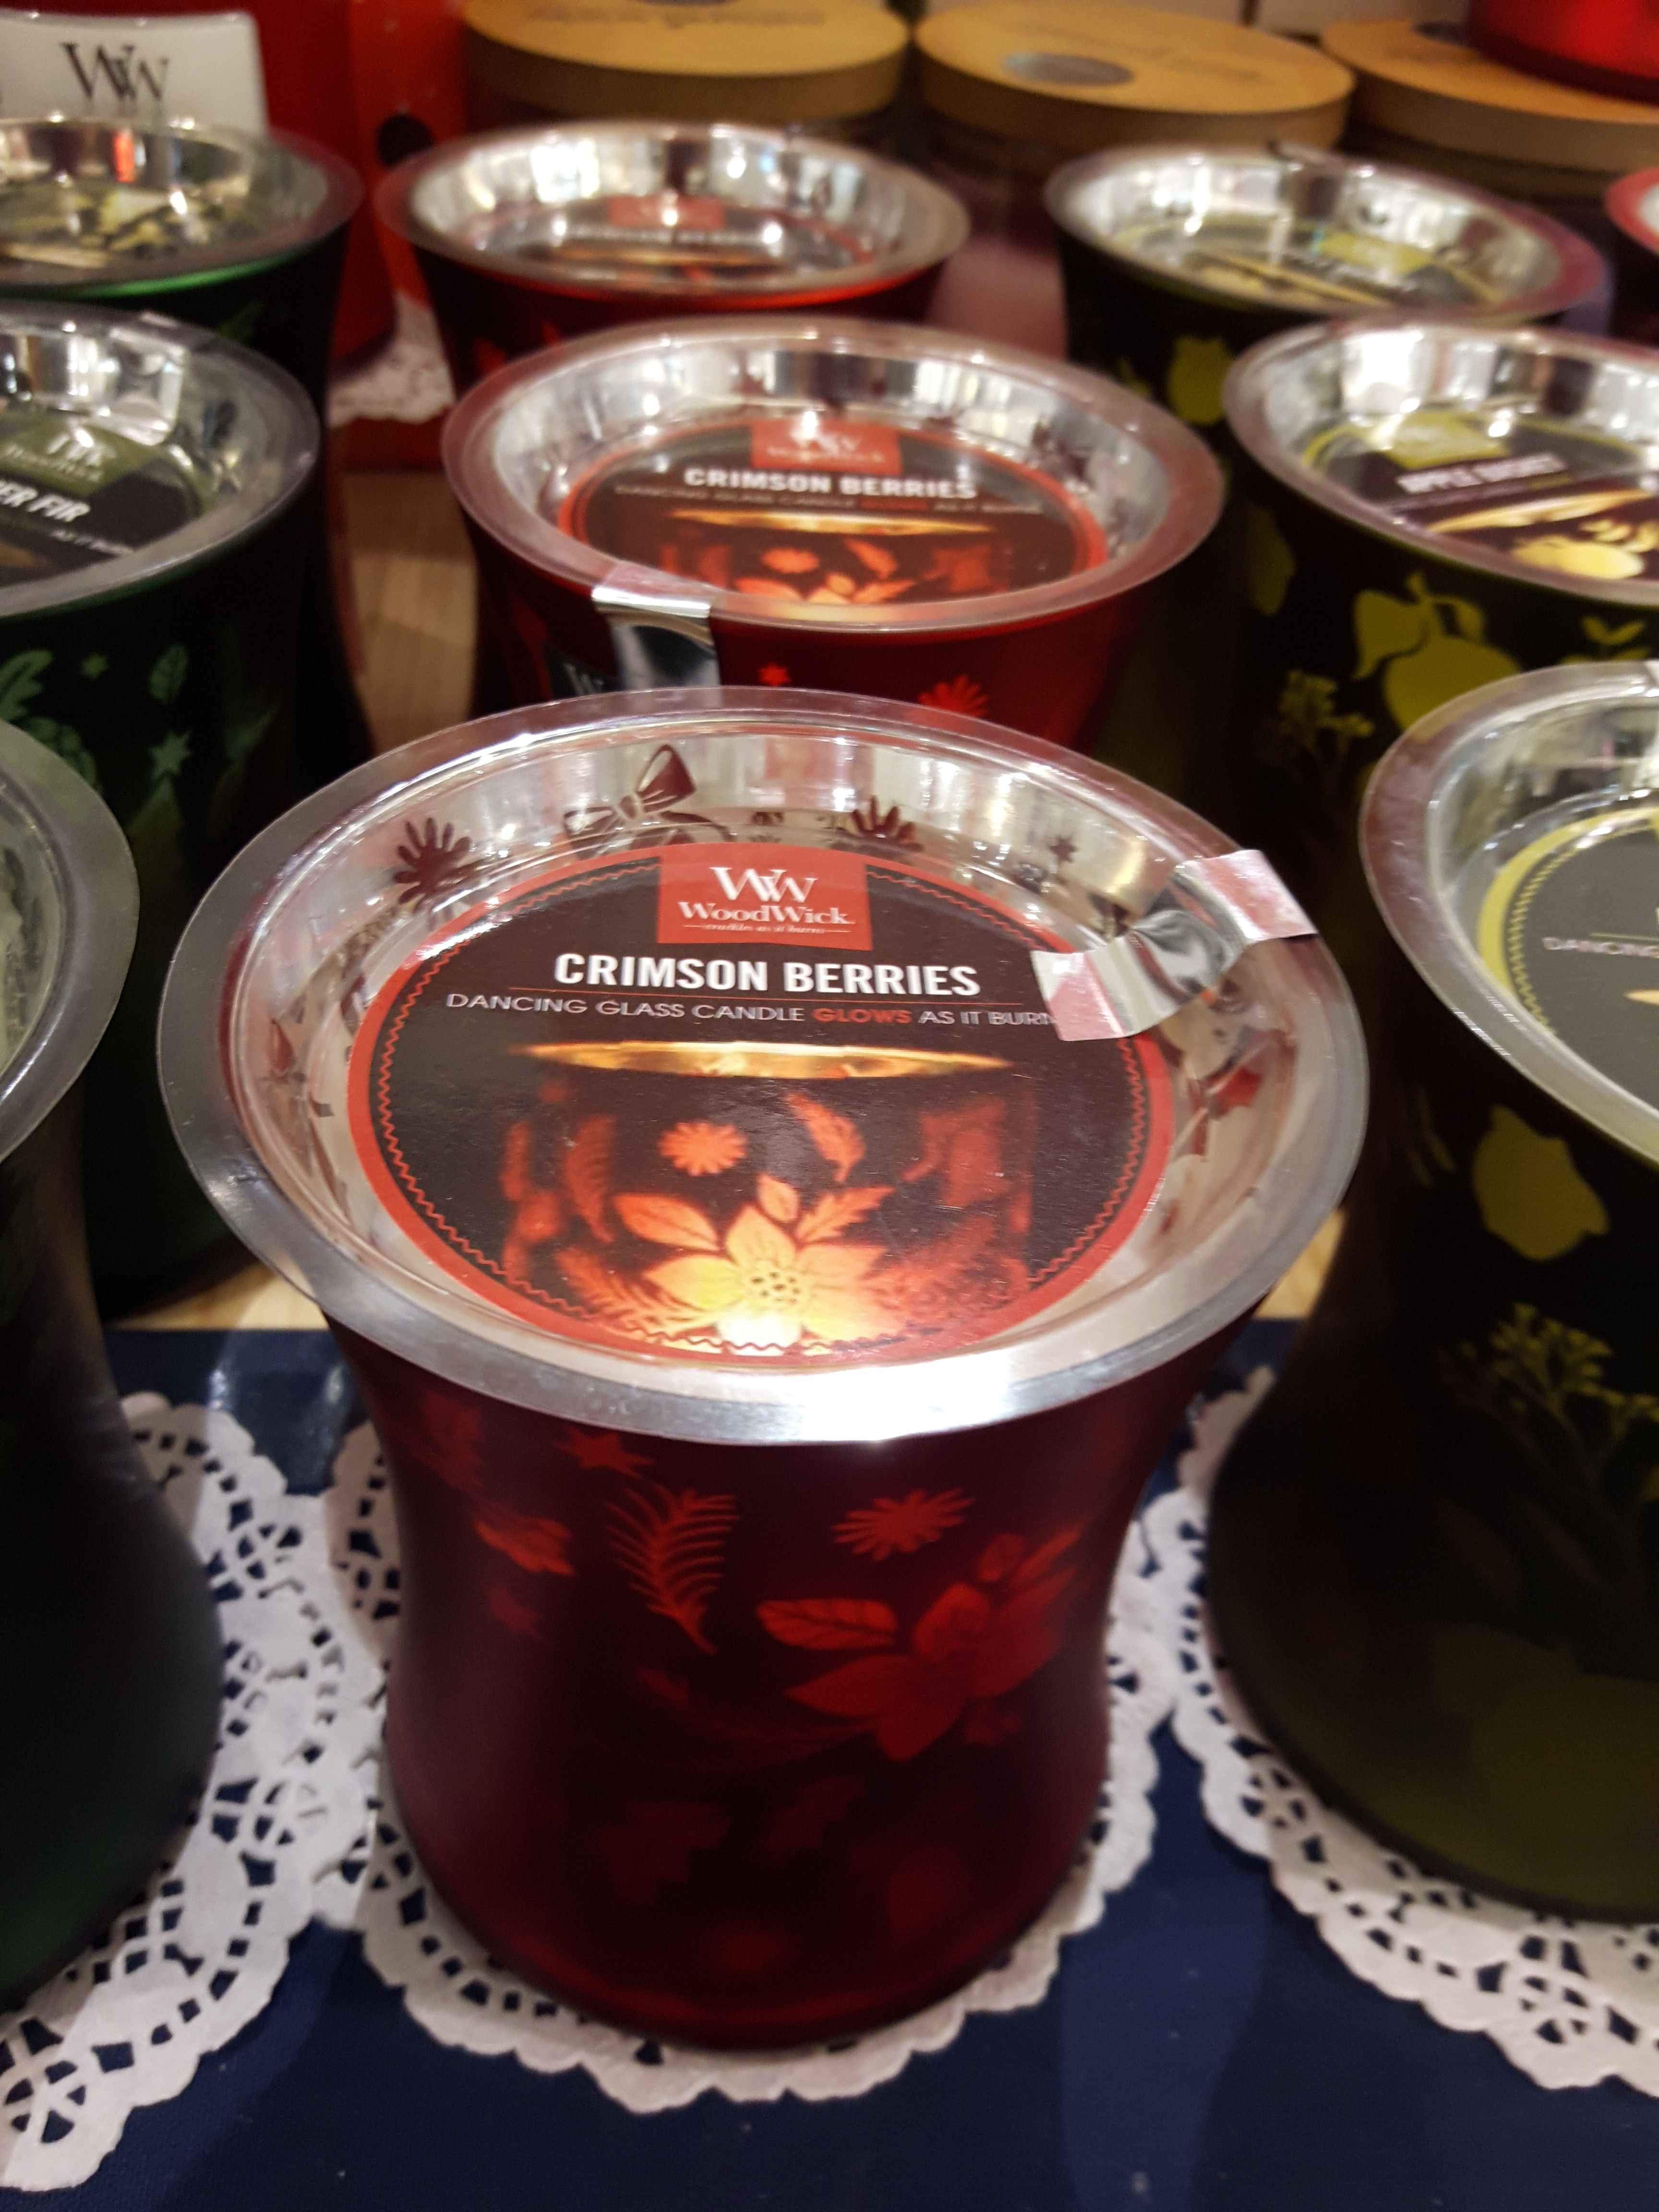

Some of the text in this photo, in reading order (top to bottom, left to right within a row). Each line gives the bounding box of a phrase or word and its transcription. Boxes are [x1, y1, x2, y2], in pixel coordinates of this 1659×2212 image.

[683, 467, 977, 499] CRIMSON BERRIES
[678, 902, 855, 925] WoodWick
[554, 953, 981, 996] CRIMSON BERRIES
[446, 993, 588, 1014] DANCING
[595, 998, 685, 1018] GLASS
[691, 1004, 805, 1022] CANDLE
[812, 1008, 911, 1023] GLOWS
[918, 1010, 956, 1025] AS
[960, 1011, 981, 1025] IT
